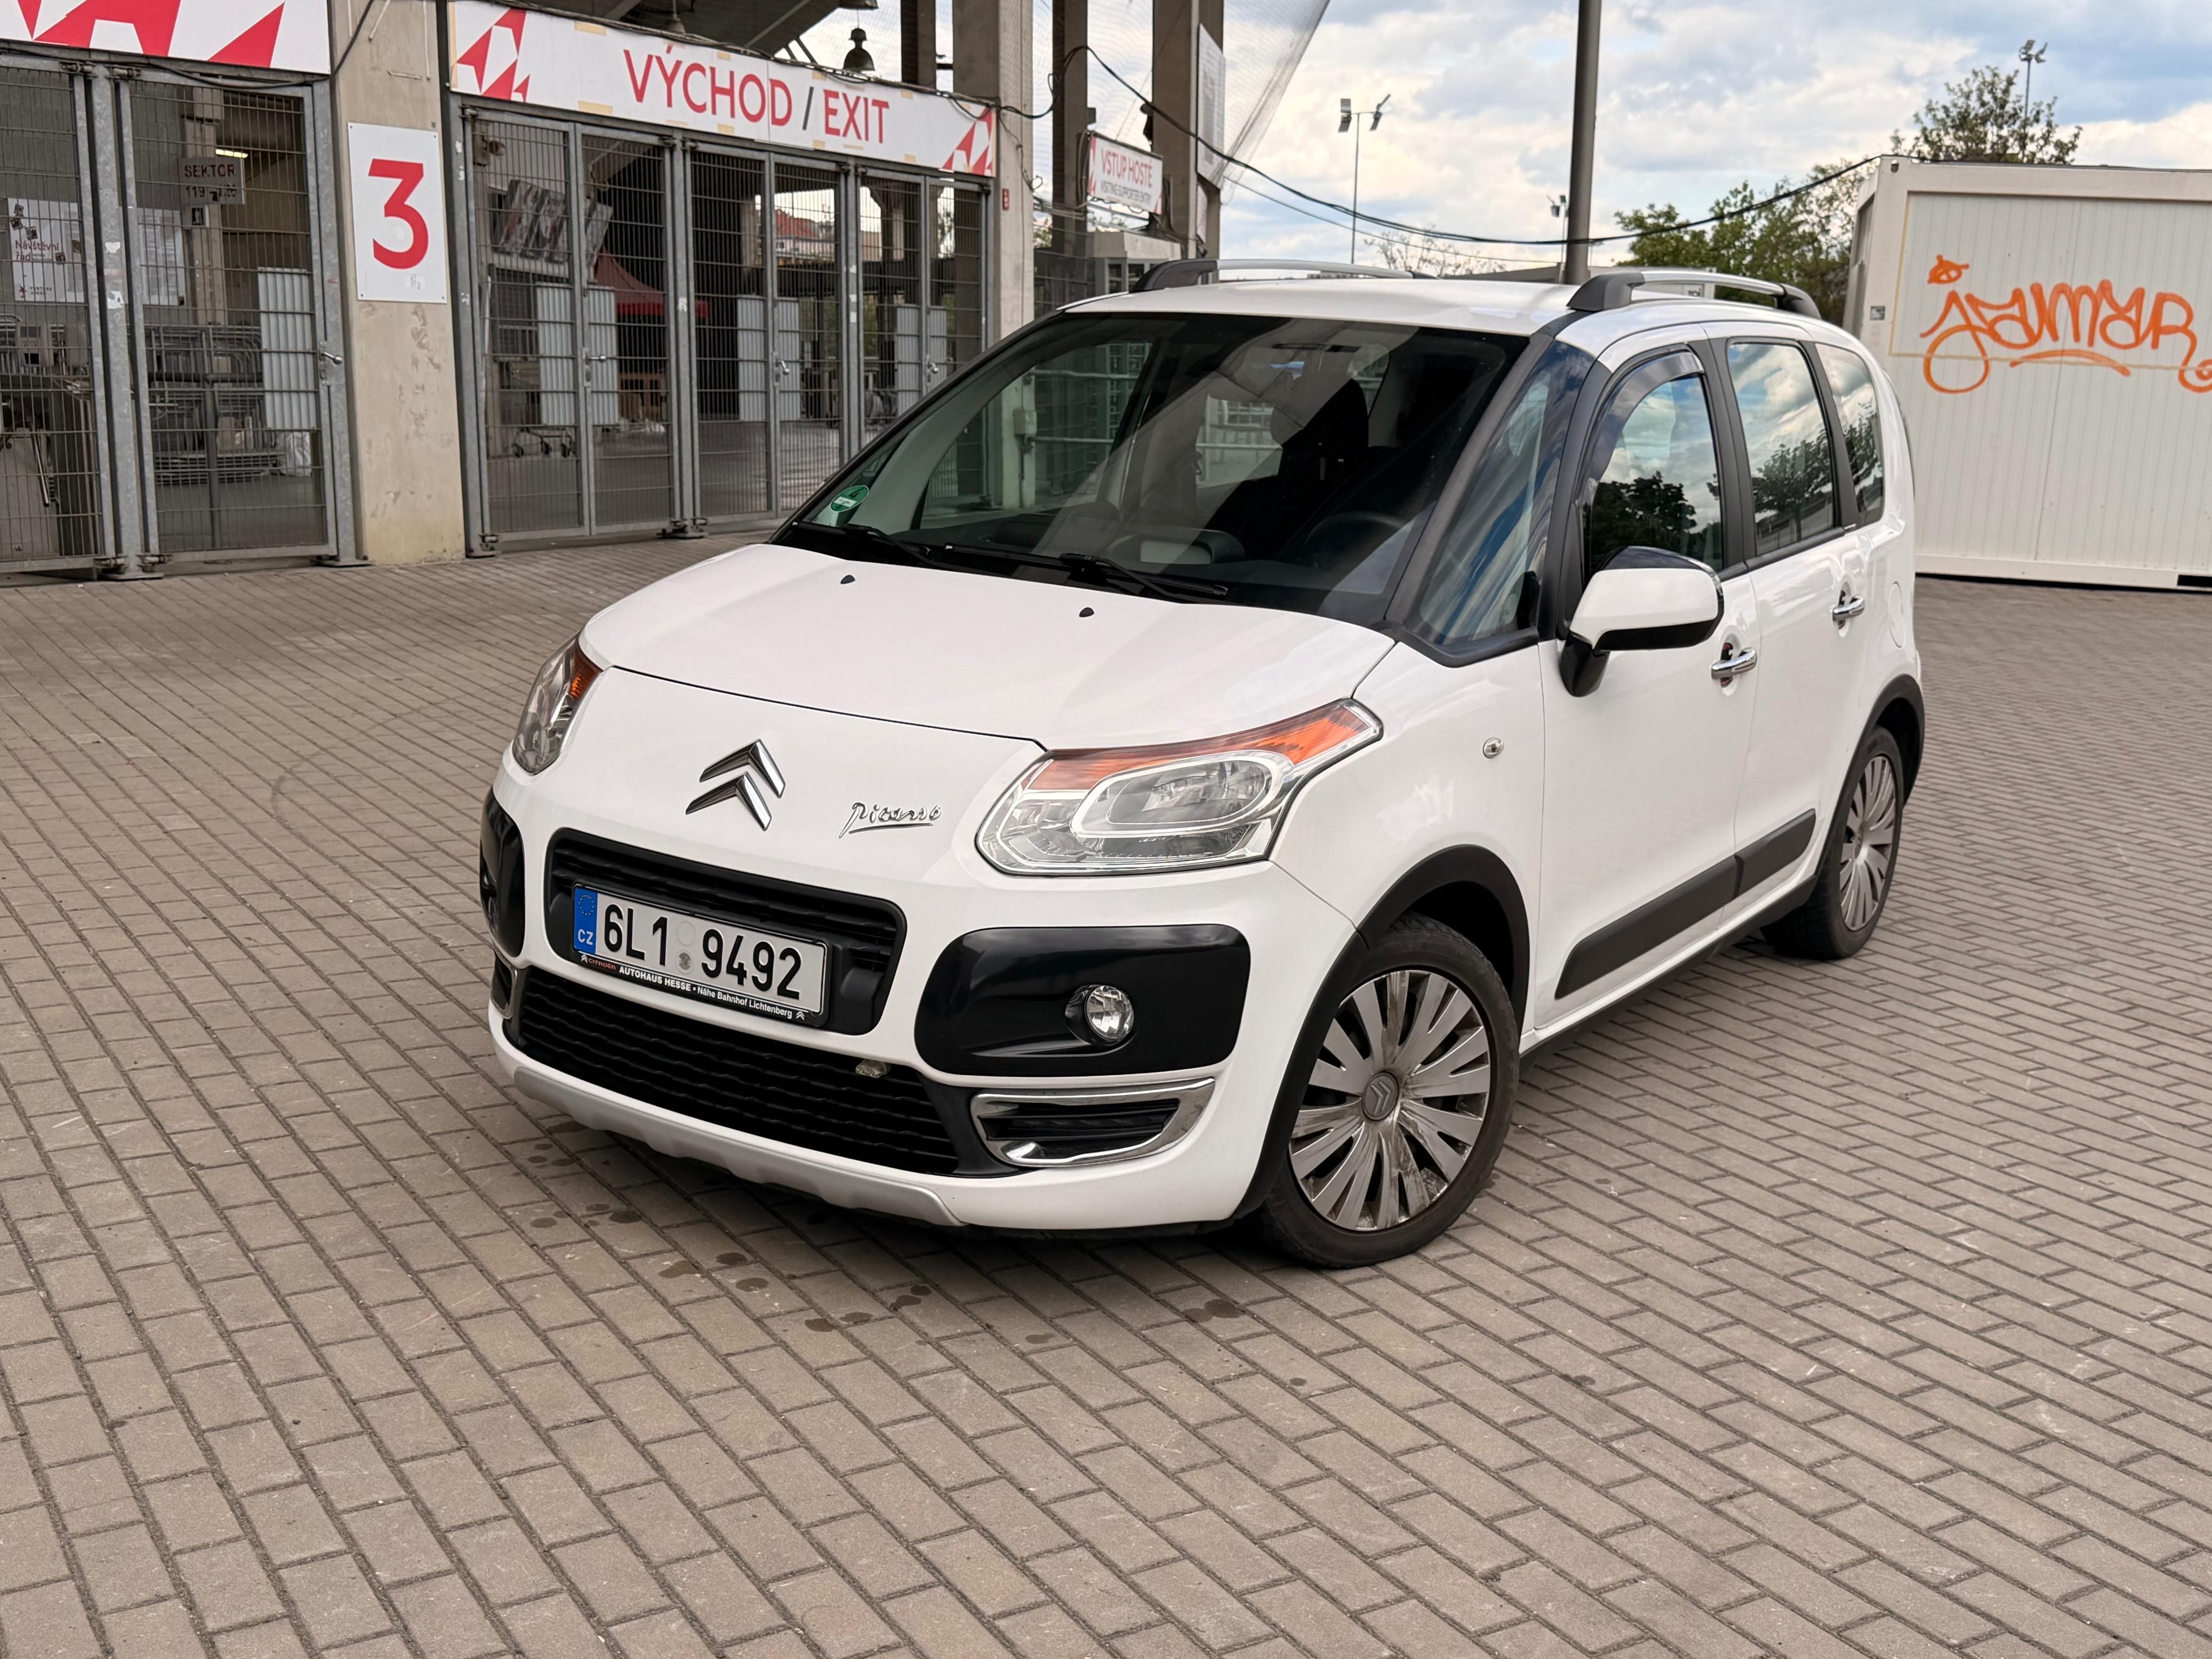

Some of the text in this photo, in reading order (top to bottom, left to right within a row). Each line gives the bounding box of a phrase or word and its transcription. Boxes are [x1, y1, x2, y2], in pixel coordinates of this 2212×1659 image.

[624, 45, 793, 126] VÝCHOD
[823, 89, 890, 144] EXIT
[184, 164, 235, 178] SEKTOR
[1101, 148, 1128, 179] VSTUP
[368, 158, 428, 269] 3
[838, 802, 941, 839] Picasso
[578, 929, 594, 945] CZ
[604, 904, 802, 1000] 6L1 9492
[619, 966, 663, 984] AUTOHAUS
[664, 978, 691, 992] HESSE
[697, 986, 716, 998] Nähe
[717, 991, 748, 1006] Bahnhof
[749, 999, 793, 1019] Lichtenberg
